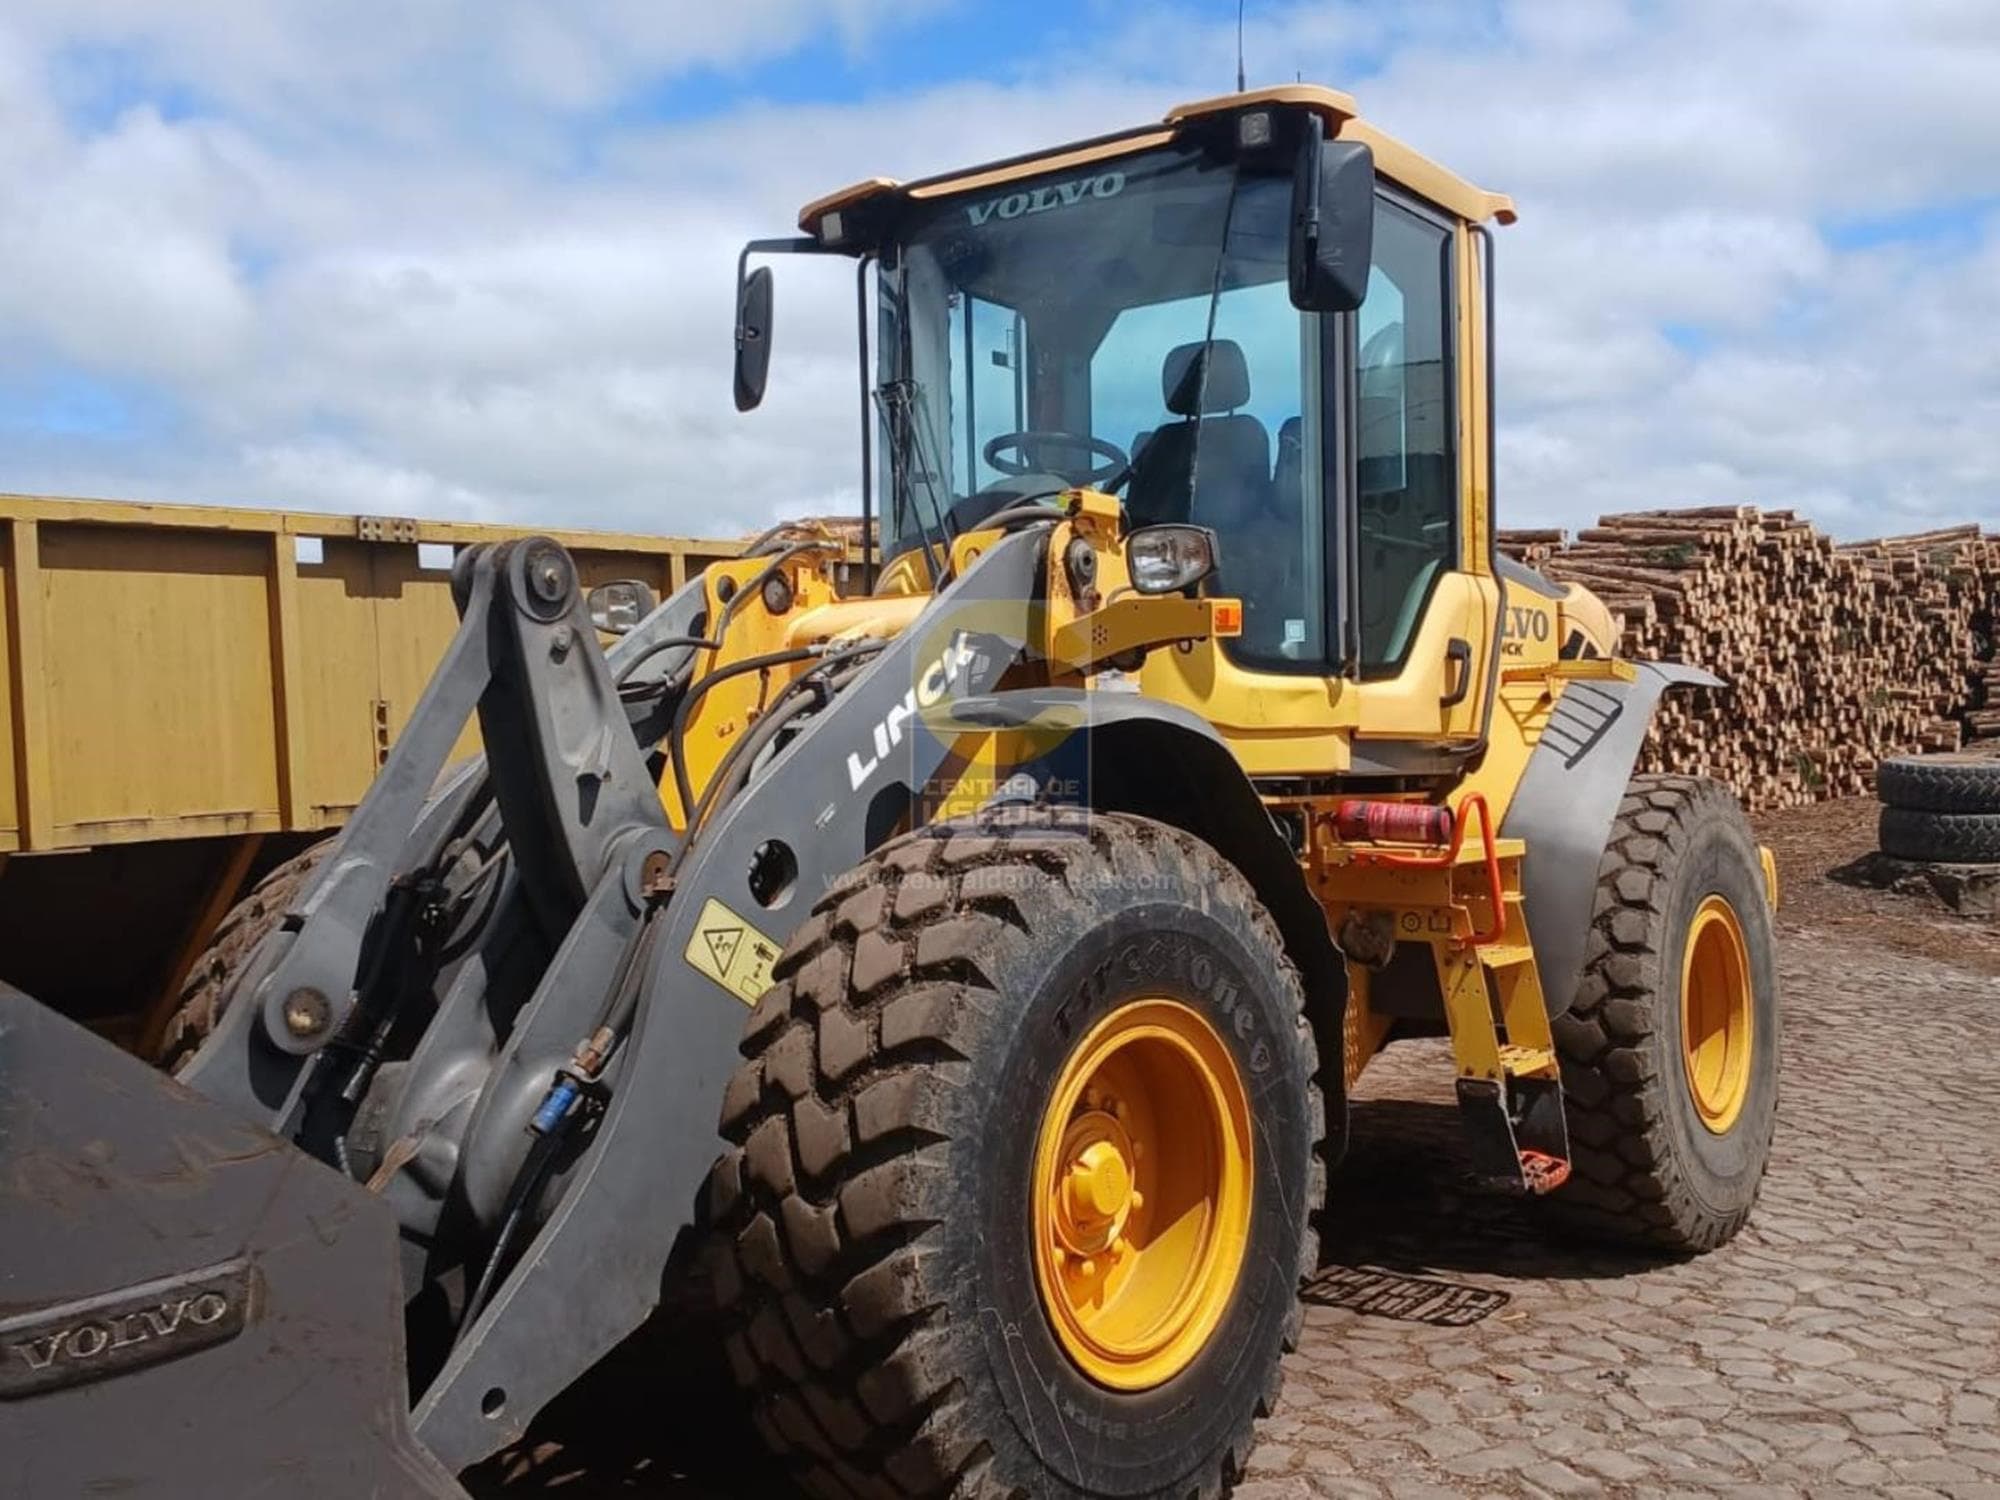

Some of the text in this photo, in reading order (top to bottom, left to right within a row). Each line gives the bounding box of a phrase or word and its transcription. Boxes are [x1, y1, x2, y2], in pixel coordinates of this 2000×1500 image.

[966, 172, 1127, 226] VOLVO
[847, 630, 976, 792] LINCK
[12, 1293, 227, 1369] VOLVO
